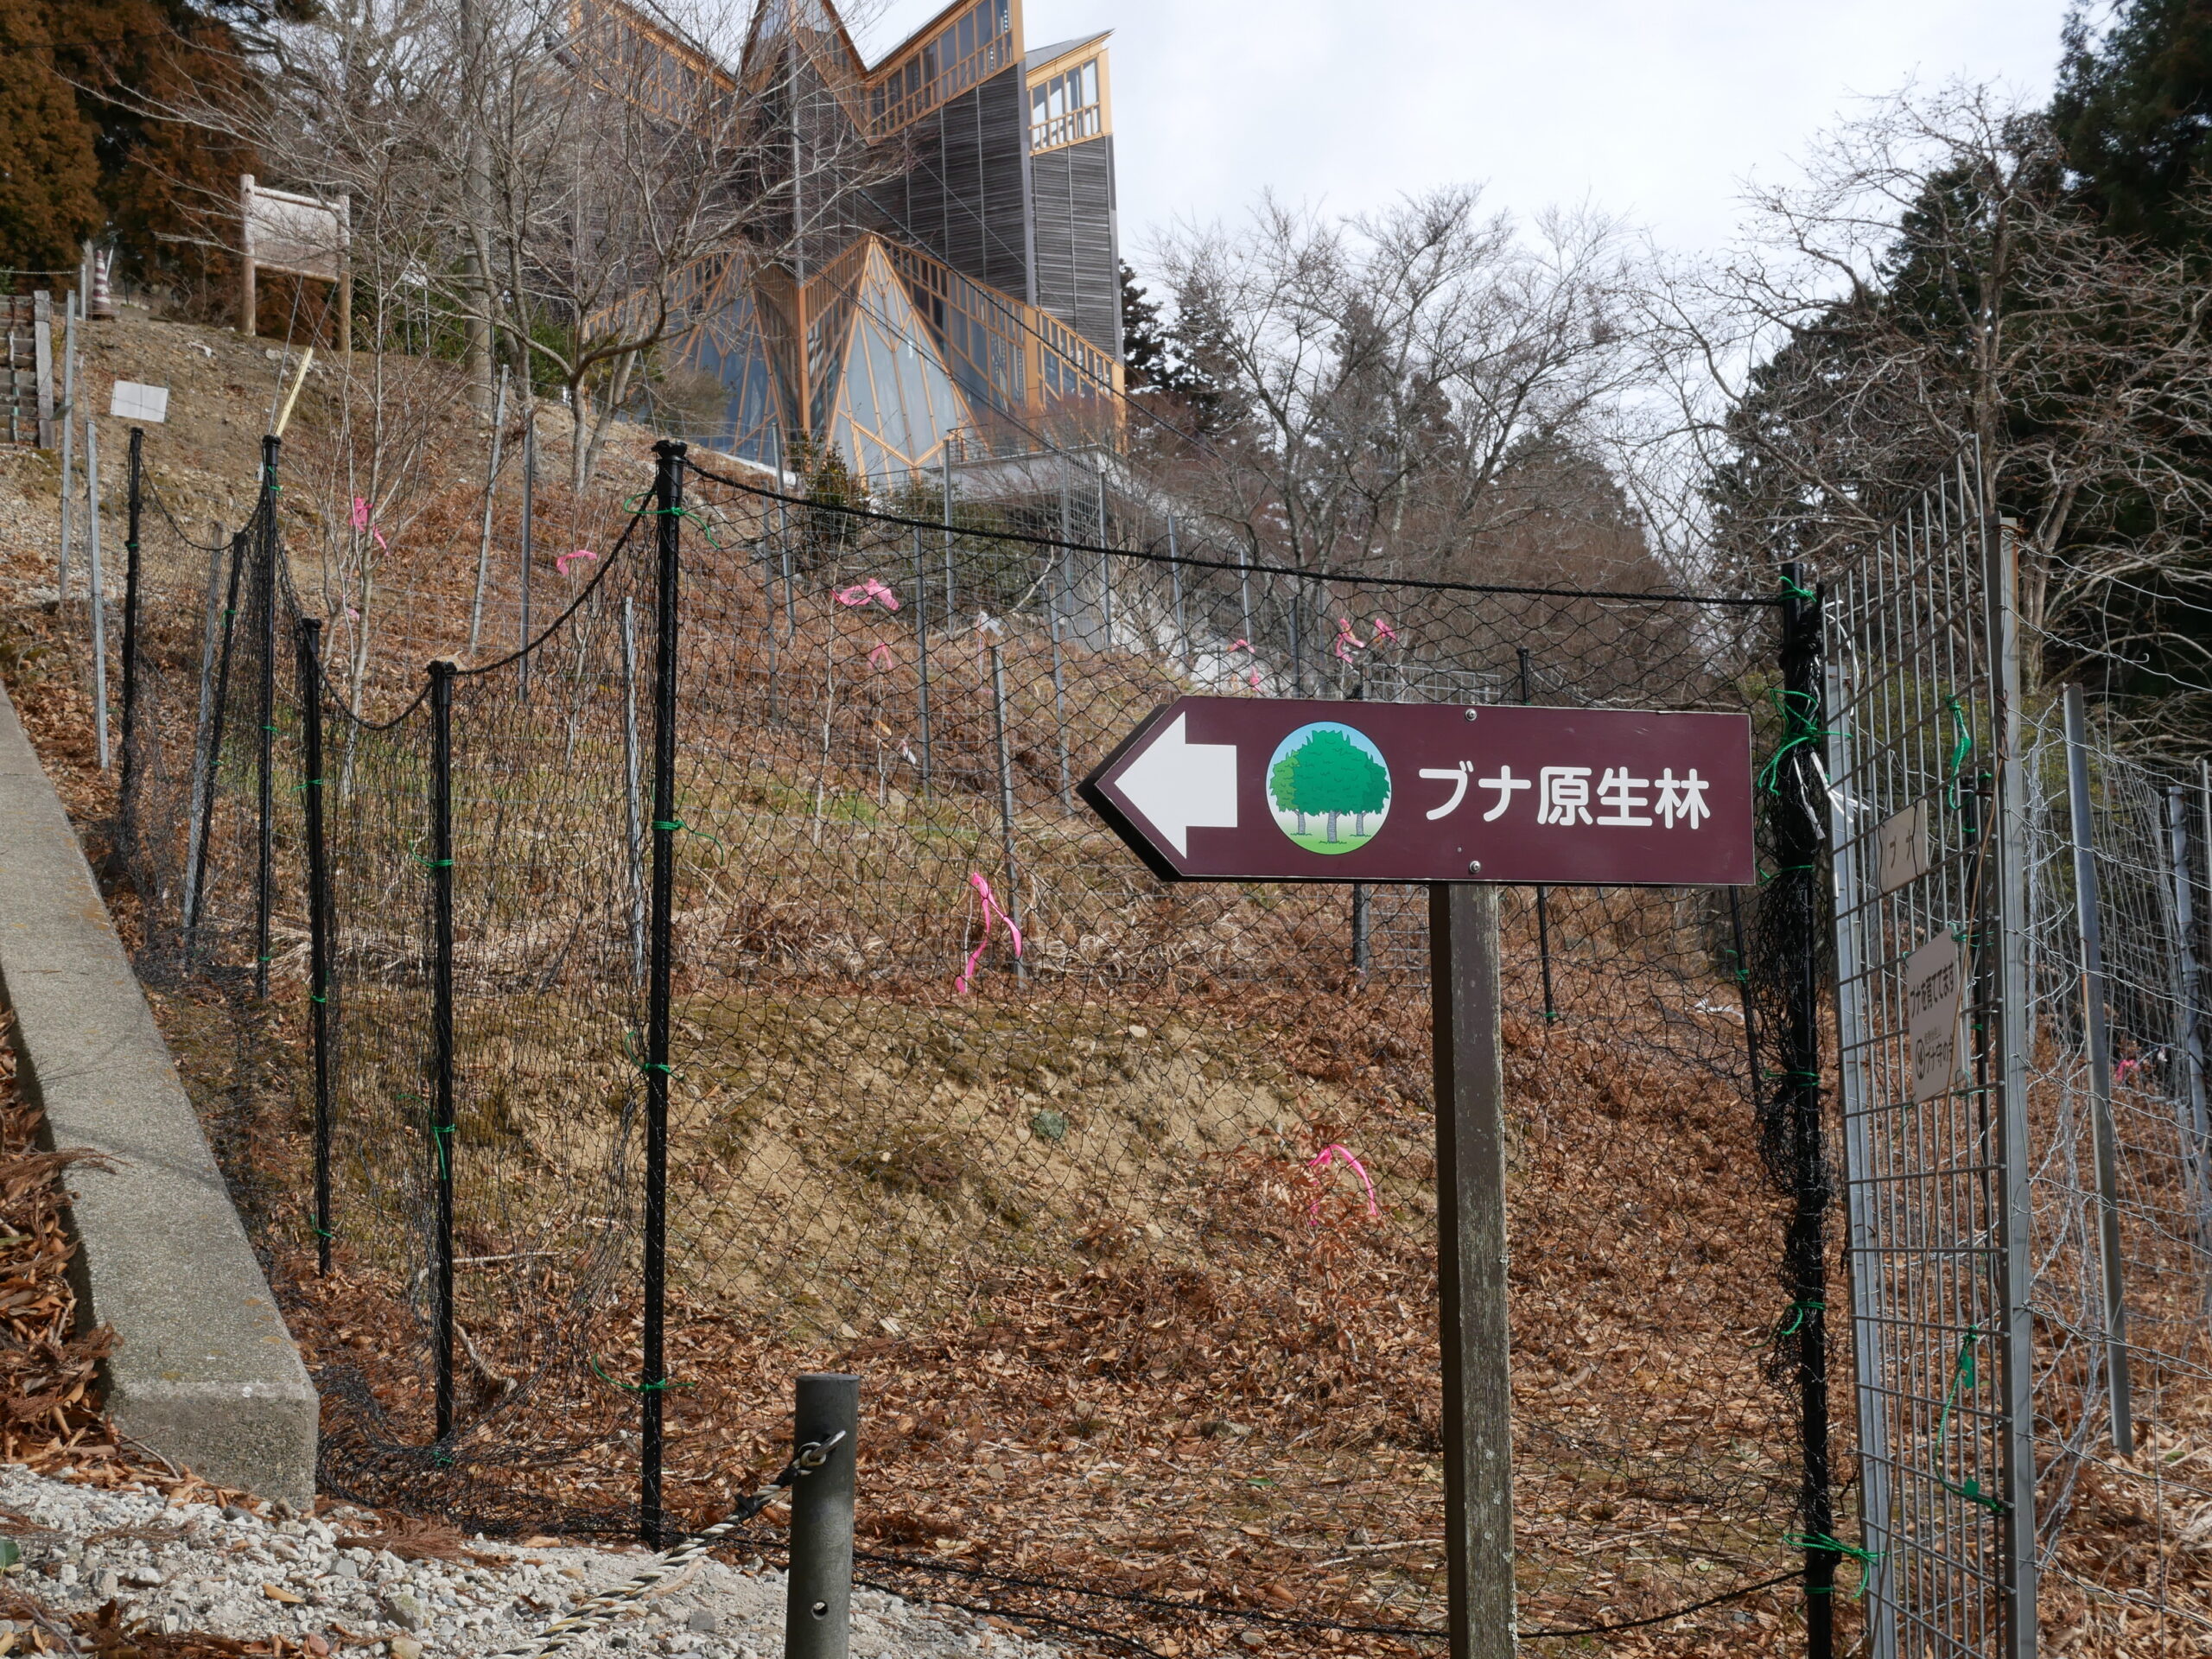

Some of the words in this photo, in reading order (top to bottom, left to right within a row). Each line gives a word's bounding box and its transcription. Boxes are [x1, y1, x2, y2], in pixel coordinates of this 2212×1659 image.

[1419, 760, 1711, 830] ブナ原生林
